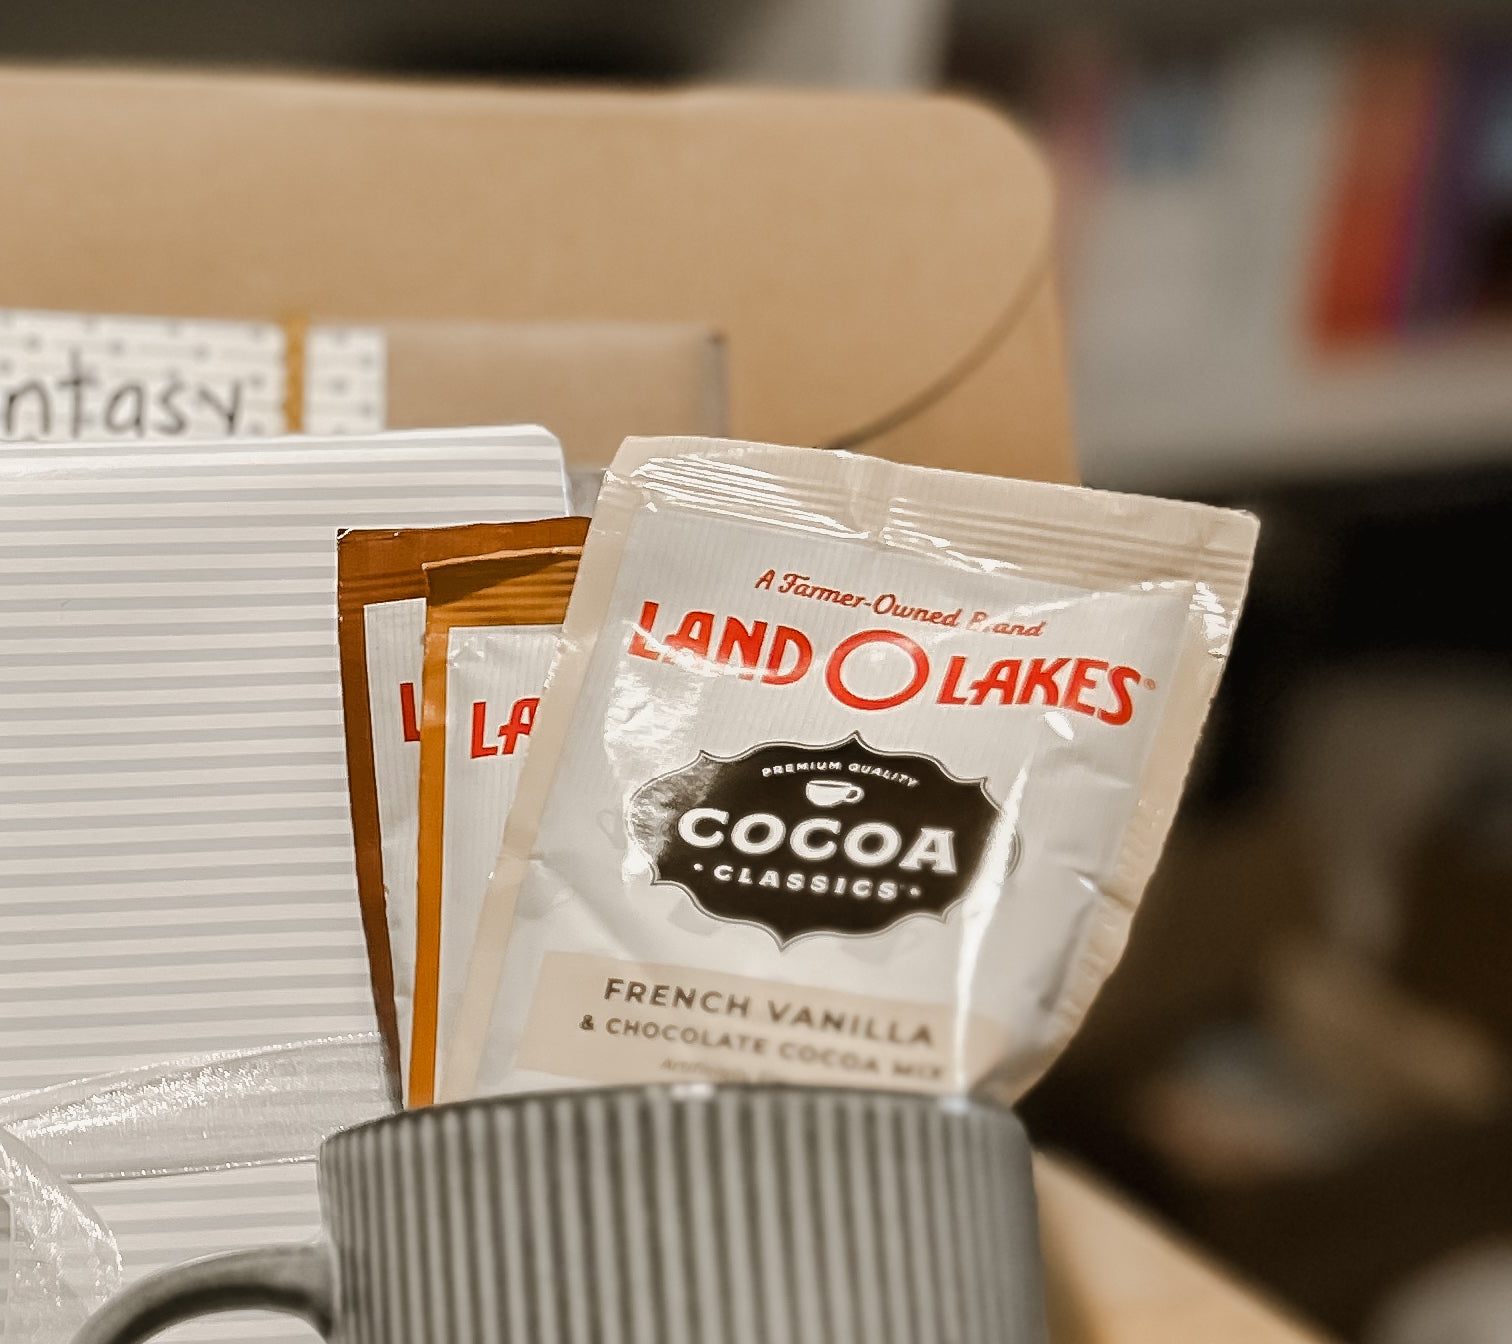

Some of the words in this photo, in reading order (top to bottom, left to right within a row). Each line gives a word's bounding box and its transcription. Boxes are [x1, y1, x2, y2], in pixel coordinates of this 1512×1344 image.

[754, 568, 777, 590] A
[778, 572, 963, 628] Farmer-Owned
[627, 600, 814, 686] LAND
[825, 629, 930, 711] O
[936, 655, 1143, 727] LAKES
[470, 697, 541, 759] LA
[761, 761, 843, 778] PREMIUM
[848, 762, 921, 787] QUALITY
[677, 807, 958, 875] COCOA
[713, 863, 899, 902] CLASSICS
[603, 977, 751, 1018] FRENCH
[767, 999, 935, 1048] VANILLA
[579, 1014, 595, 1032] &
[605, 1017, 768, 1055] CHOCOLATE
[777, 1041, 880, 1074] COCOA
[891, 1061, 945, 1081] MIX
